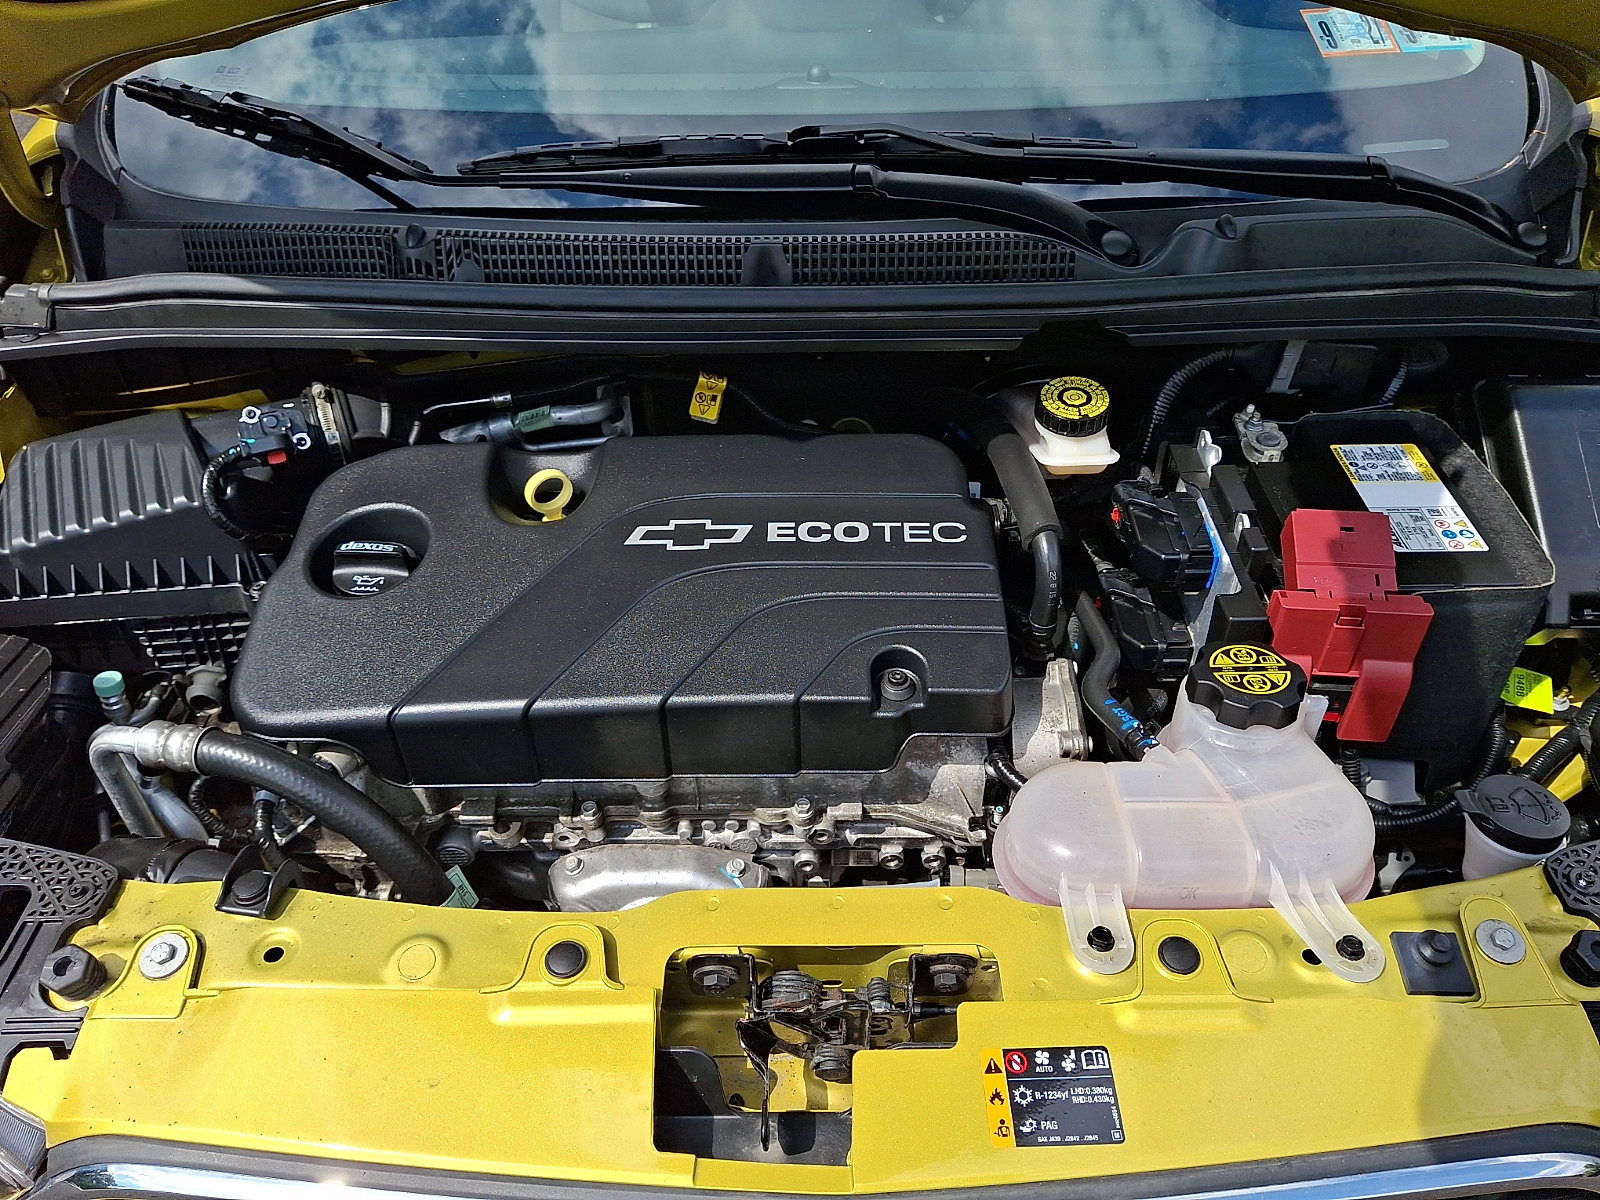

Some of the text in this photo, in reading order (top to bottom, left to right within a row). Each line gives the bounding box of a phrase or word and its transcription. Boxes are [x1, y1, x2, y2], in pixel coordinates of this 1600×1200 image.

[766, 521, 968, 543] ECOTEC
[340, 541, 395, 552] dexos
[1036, 1065, 1053, 1073] AUTO
[1035, 1090, 1069, 1100] R-1234yf
[1041, 1120, 1059, 1130] PAG
